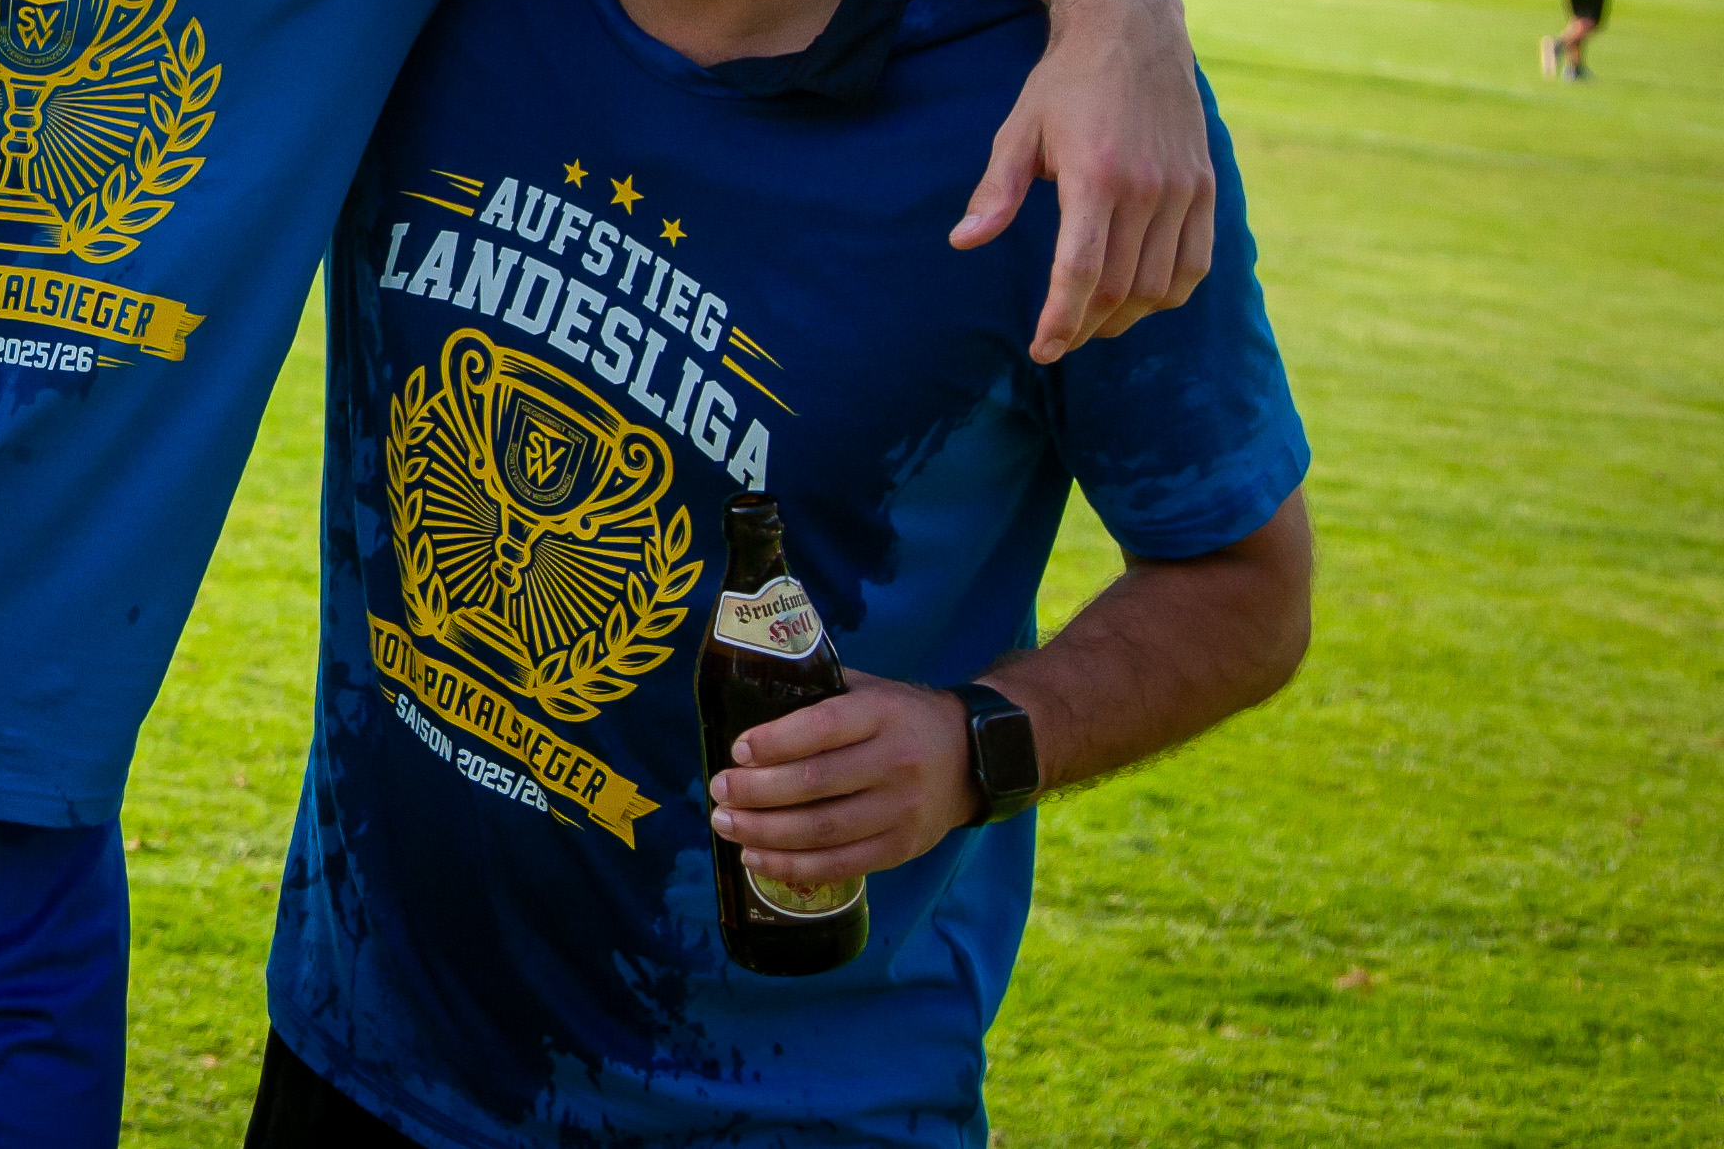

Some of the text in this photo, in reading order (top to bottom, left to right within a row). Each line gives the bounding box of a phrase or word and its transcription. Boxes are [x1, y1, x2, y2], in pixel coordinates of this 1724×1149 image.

[479, 177, 728, 352] AUFSTIEG
[379, 222, 770, 492] LANDESLIGA
[395, 693, 548, 812] SAISON 2025/26
